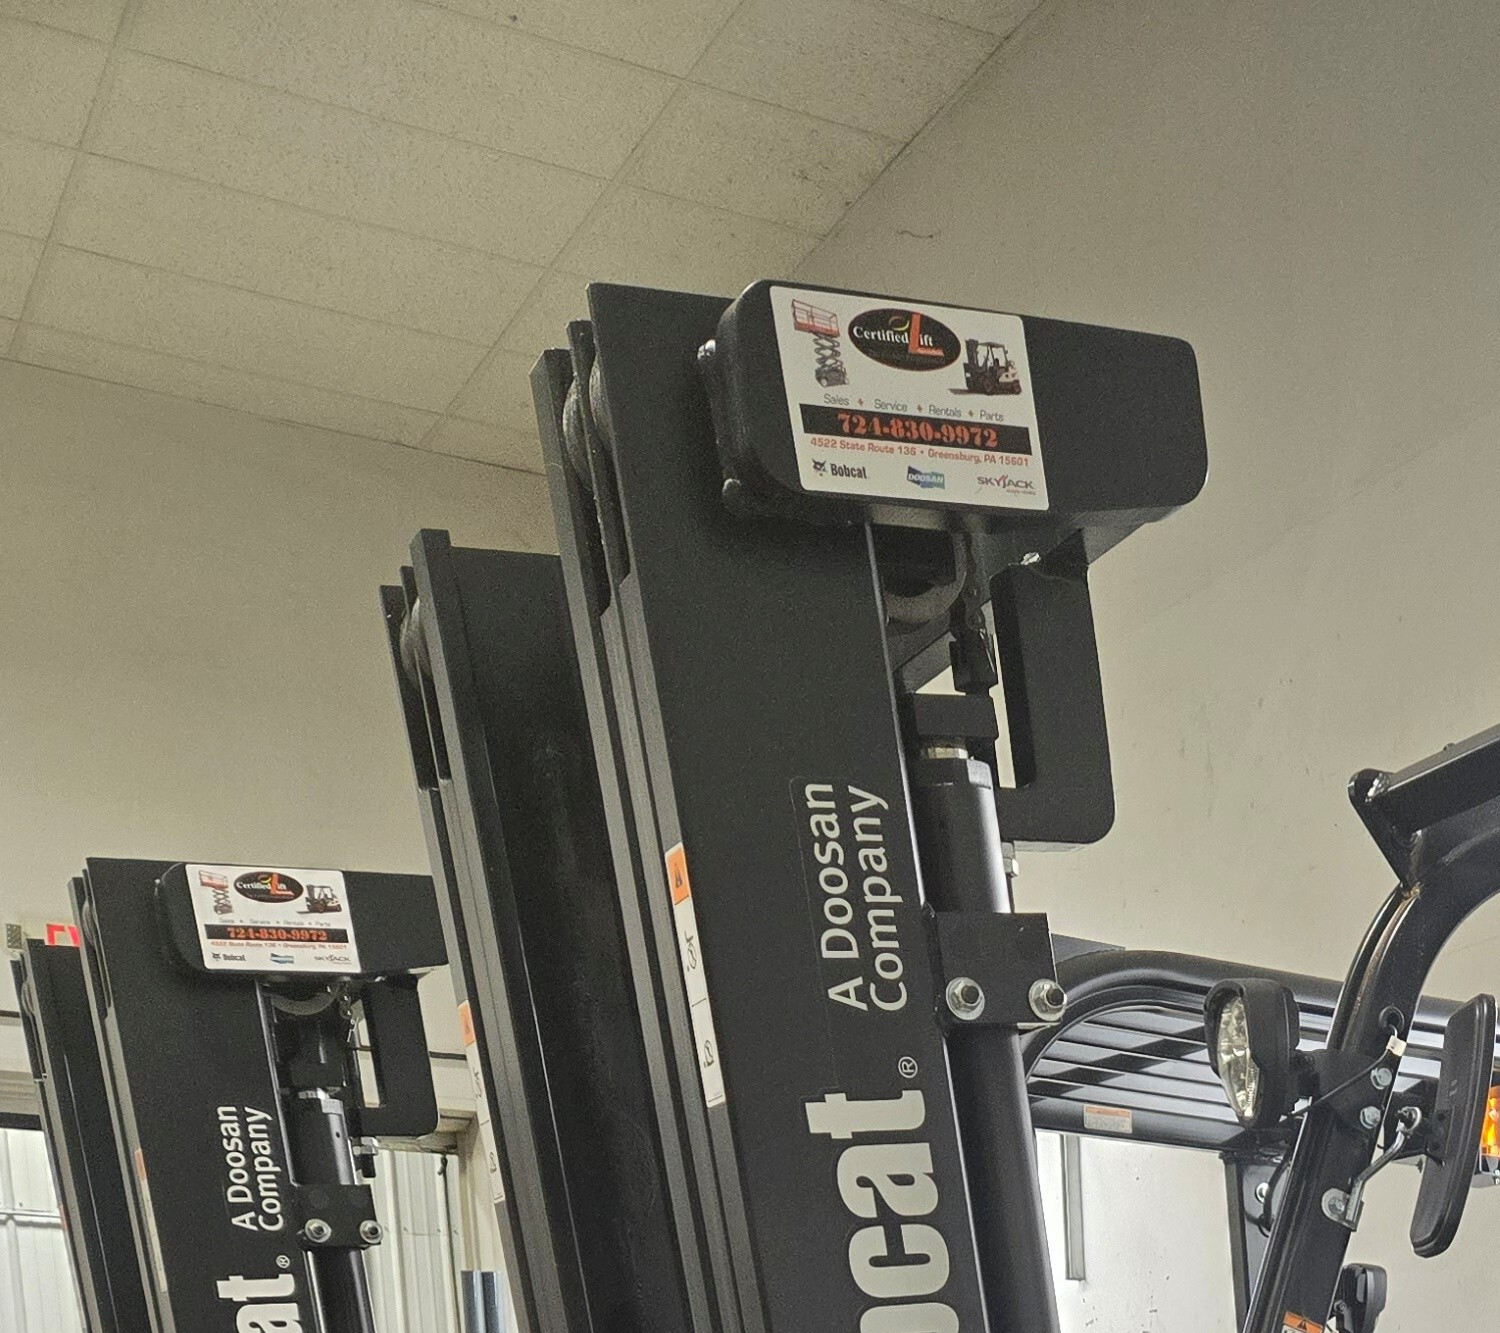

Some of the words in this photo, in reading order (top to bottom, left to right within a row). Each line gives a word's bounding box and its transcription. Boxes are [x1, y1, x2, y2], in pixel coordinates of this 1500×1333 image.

[852, 325, 910, 344] Certified
[908, 312, 945, 357] Lift
[823, 392, 850, 406] Sales
[873, 398, 908, 412] Service
[928, 404, 962, 418] Rentals
[979, 409, 1005, 422] Parts
[837, 411, 998, 448] 724-830-9972
[810, 437, 838, 449] 4522
[839, 440, 865, 452] State
[867, 442, 895, 455] Route
[897, 445, 917, 456] 136
[983, 454, 997, 464] PA
[999, 455, 1029, 467] 15601
[829, 463, 868, 479] Bobcat
[805, 784, 860, 959] Doosan
[847, 785, 908, 1012] Company
[226, 927, 328, 941] 724-830-9972
[828, 977, 868, 1011] A
[217, 1107, 253, 1202] Doosan
[244, 1107, 284, 1232] Company
[231, 1211, 258, 1231] A
